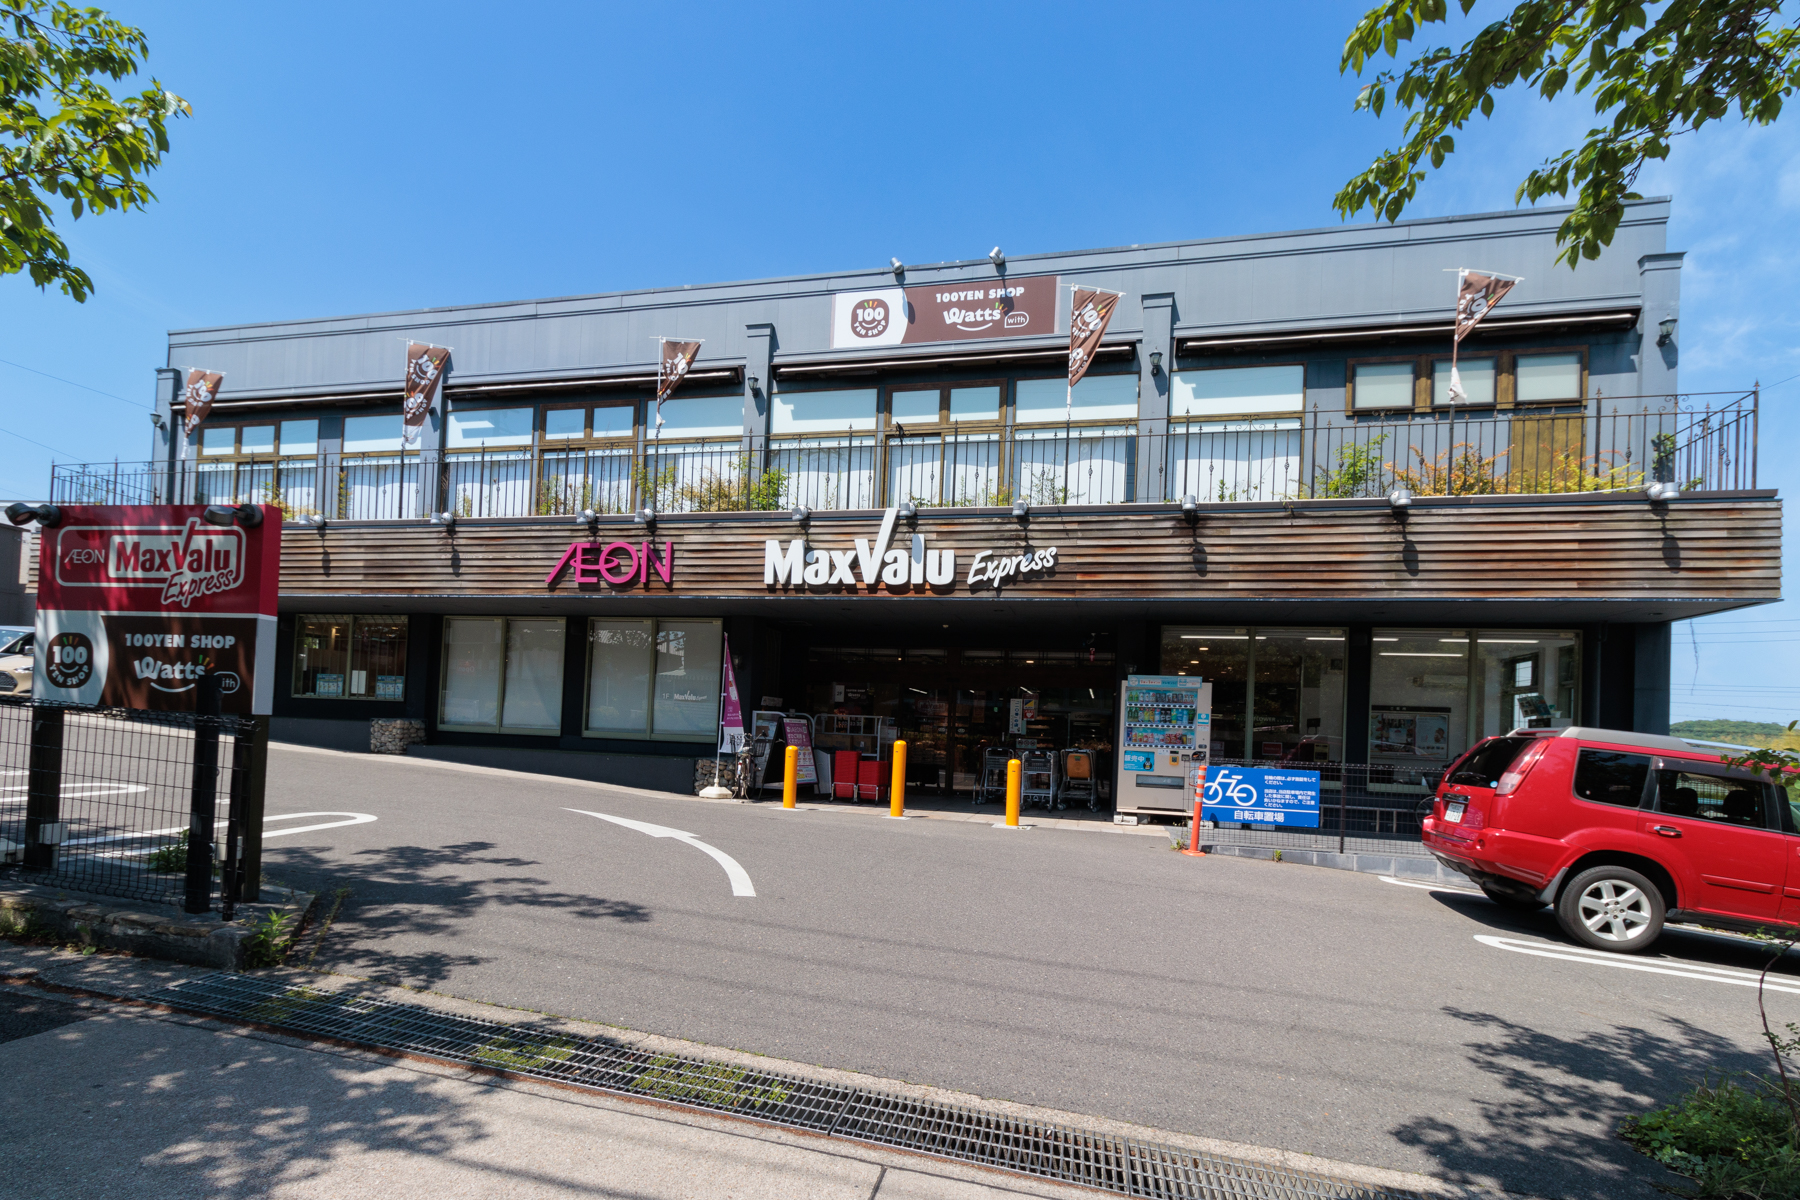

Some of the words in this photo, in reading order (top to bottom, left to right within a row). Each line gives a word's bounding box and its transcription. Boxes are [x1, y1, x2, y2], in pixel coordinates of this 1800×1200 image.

[935, 289, 984, 303] 100YEN
[988, 286, 1025, 299] SHOP
[856, 307, 885, 322] 100
[943, 306, 1001, 325] Watts
[1007, 315, 1026, 324] with
[1081, 302, 1102, 331] 100
[854, 320, 868, 336] YEN
[867, 319, 887, 337] SHOP
[418, 354, 438, 380] 100
[411, 373, 431, 385] SHOP
[194, 379, 212, 402] 100
[115, 521, 230, 573] MaxValu
[764, 508, 955, 586] MaxValu
[967, 546, 1058, 587] Express
[163, 569, 235, 604] Express
[125, 633, 185, 648] 100YEN
[191, 634, 235, 649] SHOP
[53, 646, 88, 664] 100
[49, 664, 64, 684] YEN
[66, 664, 90, 686] SHOP
[133, 656, 206, 680] Watts
[1233, 810, 1285, 823] 自転車置場
